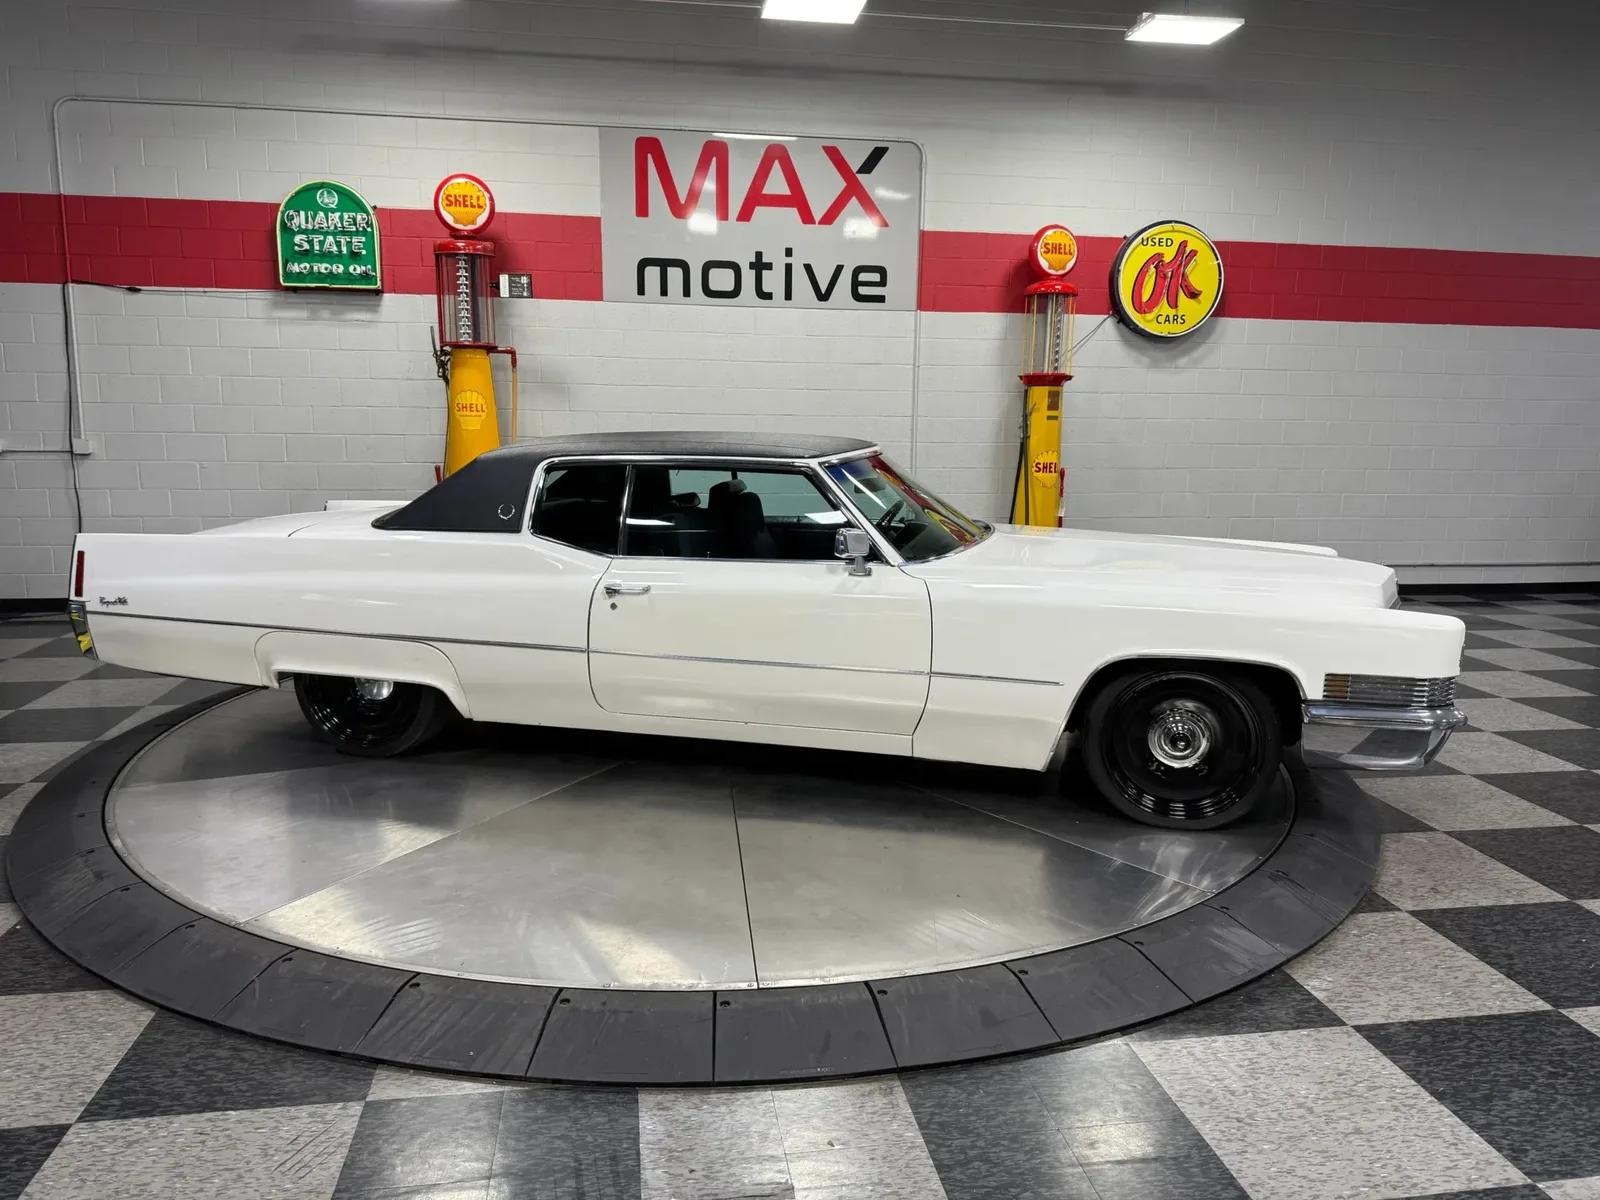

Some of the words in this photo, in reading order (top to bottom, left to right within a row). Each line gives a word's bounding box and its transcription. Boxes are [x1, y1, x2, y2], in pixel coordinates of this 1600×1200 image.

[635, 136, 889, 227] MAX
[445, 194, 484, 209] SHELL
[284, 210, 372, 231] QUAKER
[294, 234, 366, 254] STATE
[1043, 242, 1073, 255] SHELL
[1141, 237, 1174, 247] USED
[287, 262, 344, 274] MOTOR
[349, 264, 376, 276] OIL
[637, 247, 888, 303] motive
[1131, 240, 1203, 314] OK
[1156, 314, 1186, 324] CARS
[456, 402, 486, 413] SHELL
